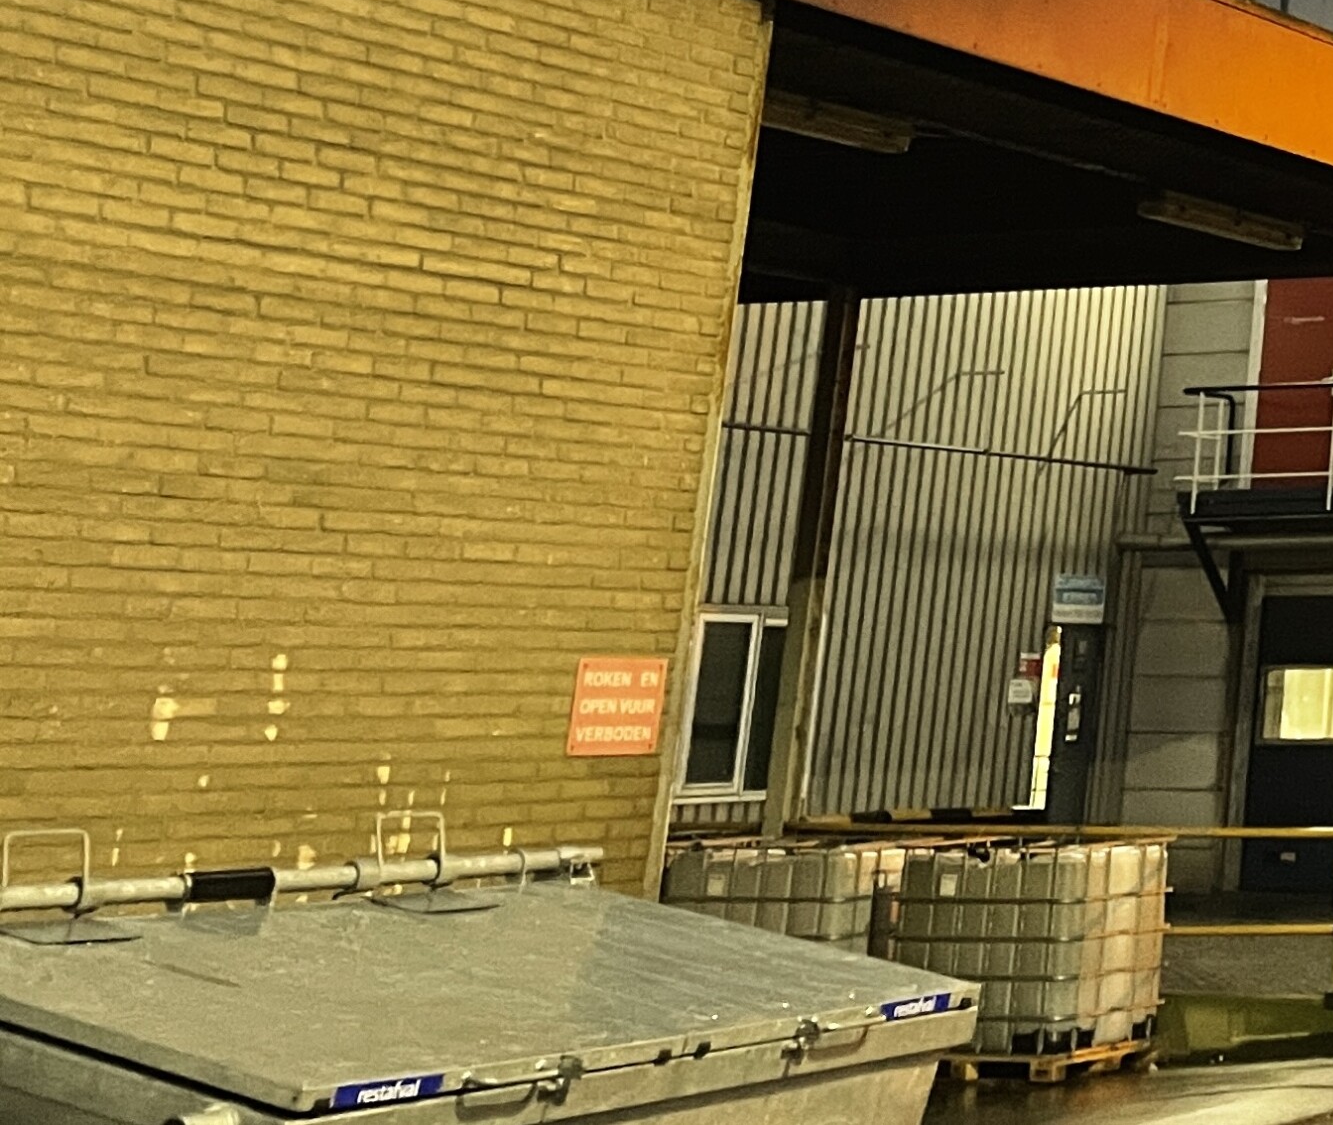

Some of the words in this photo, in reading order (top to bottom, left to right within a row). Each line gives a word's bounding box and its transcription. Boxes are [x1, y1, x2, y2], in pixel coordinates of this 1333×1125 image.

[583, 671, 633, 687] ROKEN
[640, 671, 659, 687] EN
[579, 699, 618, 714] OPEN
[619, 699, 656, 714] VUUR
[575, 725, 652, 742] VERBODEN
